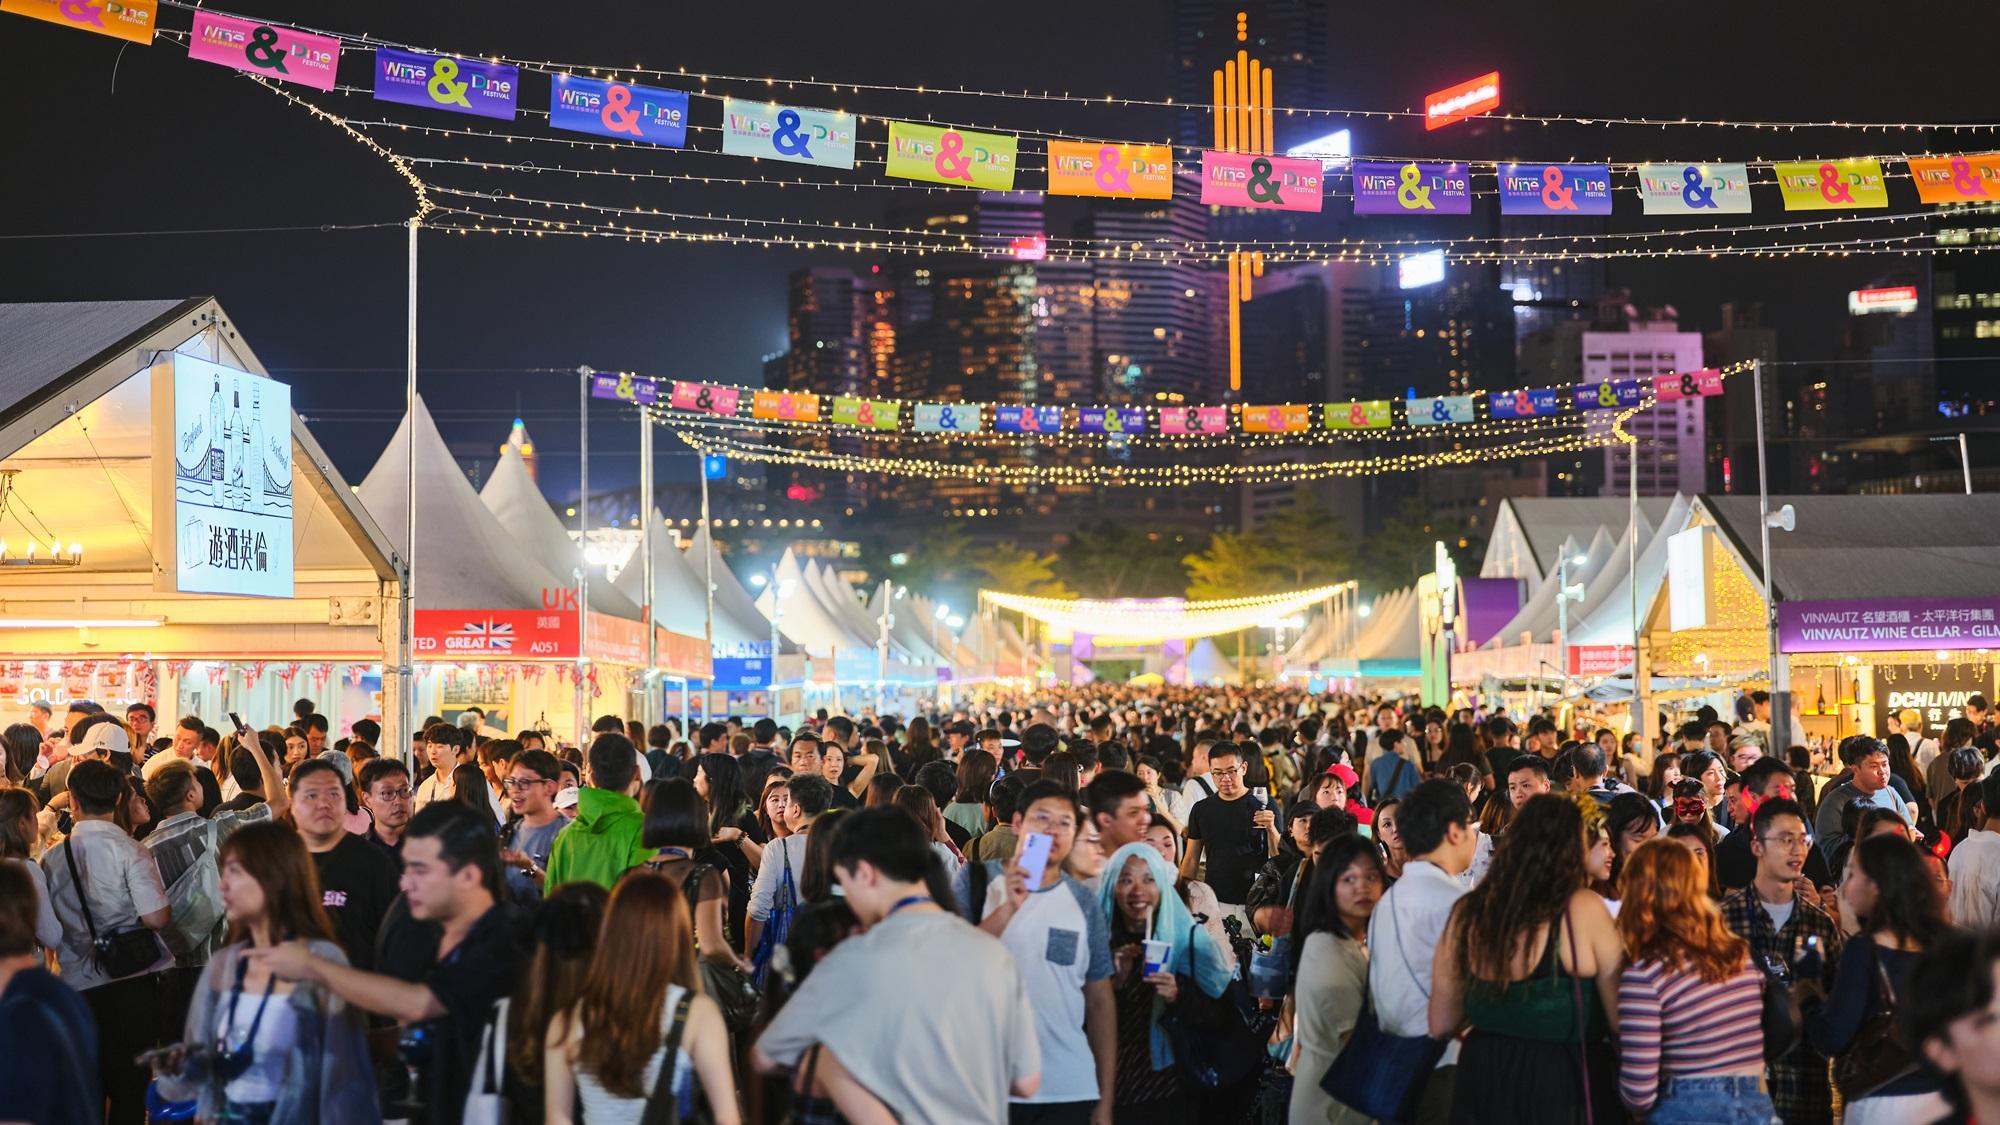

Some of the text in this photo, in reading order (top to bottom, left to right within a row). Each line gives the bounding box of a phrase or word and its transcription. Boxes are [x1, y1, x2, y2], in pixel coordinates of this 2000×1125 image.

[106, 2, 149, 20] Dine
[119, 14, 148, 25] FESTIVAL
[245, 26, 289, 74] &
[291, 42, 332, 63] Dine
[302, 58, 330, 71] FESTIVAL
[383, 60, 427, 80] Wine
[427, 58, 473, 108] &
[472, 73, 511, 93] Dine
[483, 90, 511, 100] FESTIVAL
[559, 88, 601, 108] Wine
[601, 85, 645, 136] &
[643, 101, 682, 121] Dine
[654, 118, 680, 129] FESTIVAL
[730, 109, 849, 159] Wine & Dine
[895, 136, 934, 156] Wine
[935, 131, 974, 182] &
[976, 147, 1010, 165] Dine
[1055, 155, 1094, 171] Wine
[1094, 146, 1134, 192] &
[1133, 159, 1168, 175] Dine
[1211, 166, 1247, 182] Wine
[1246, 157, 1285, 205] &
[1284, 171, 1318, 188] Dine
[1916, 169, 1951, 183] Wine
[1951, 157, 1989, 198] &
[1359, 165, 1465, 209] Wine & Dine
[1504, 177, 1540, 191] Wine
[1541, 166, 1579, 210] &
[1573, 178, 1606, 191] Dine
[1644, 177, 1680, 191] Wine
[1682, 166, 1719, 208] &
[1712, 177, 1745, 190] Dine
[1782, 175, 1818, 188] Wine
[1819, 162, 1856, 204] &
[1847, 173, 1879, 186] Dine
[615, 375, 636, 400] &
[1598, 383, 1620, 407] &
[1681, 373, 1702, 396] &
[696, 387, 714, 410] &
[778, 396, 797, 419] &
[1432, 400, 1454, 421] &
[1515, 390, 1536, 416] &
[857, 402, 876, 426] &
[939, 407, 959, 430] &
[1020, 406, 1041, 431] &
[1103, 408, 1124, 432] &
[1185, 408, 1205, 432] &
[1268, 406, 1287, 430] &
[1349, 403, 1370, 427] &
[209, 524, 268, 573] 遊酒英倫
[541, 587, 579, 610] UK
[1801, 611, 1859, 624] VINVAUTZ
[1862, 610, 1911, 624] 名望酒櫃
[1922, 608, 1995, 623] 太平洋行集團
[445, 636, 486, 649] GREAT
[1801, 627, 1869, 641] VINVAUTZ
[1871, 626, 1907, 639] WINE
[1911, 625, 1960, 638] CELLAR
[530, 641, 558, 653] A051
